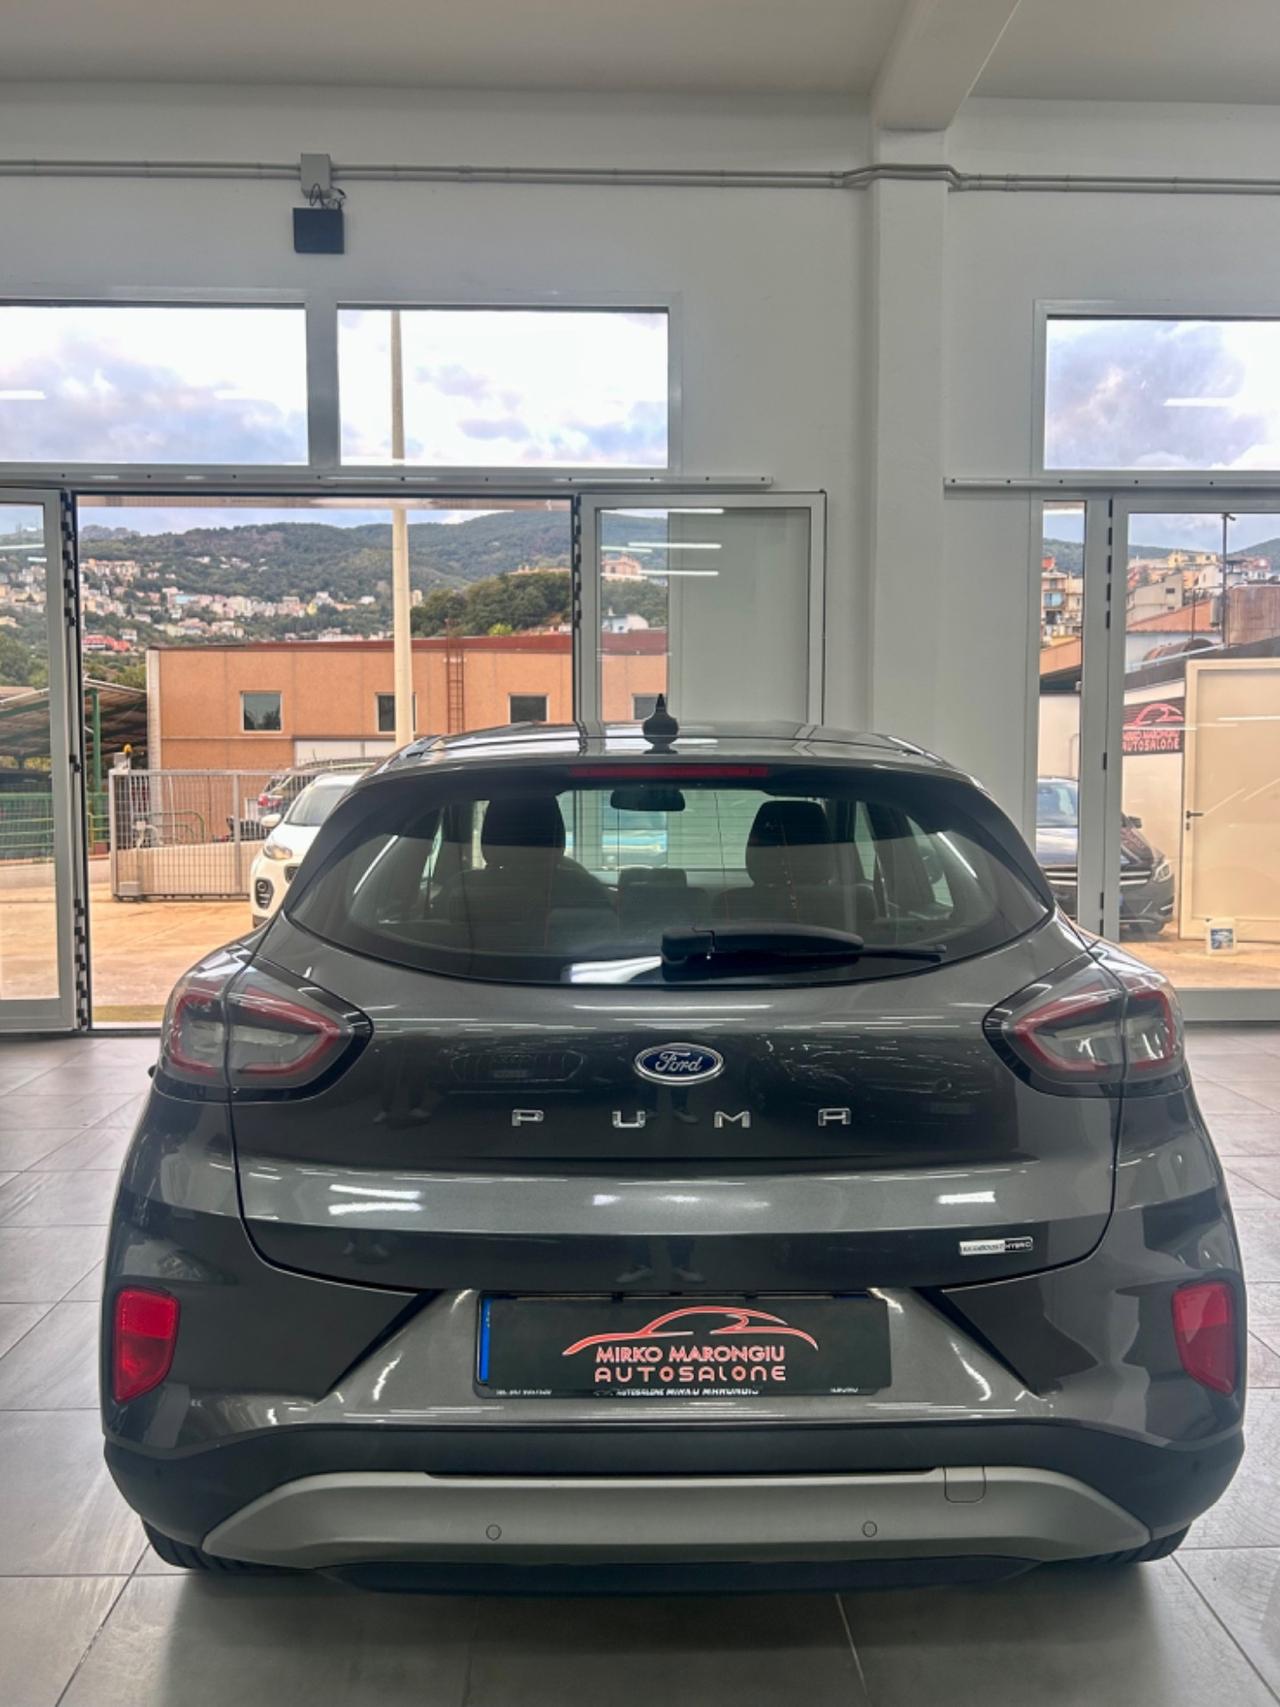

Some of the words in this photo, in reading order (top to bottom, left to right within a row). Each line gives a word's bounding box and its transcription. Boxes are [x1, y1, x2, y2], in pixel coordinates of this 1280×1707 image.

[654, 1052, 702, 1073] Ford
[511, 1107, 851, 1129] PUMA
[596, 1345, 664, 1364] MIRKO
[668, 1344, 786, 1364] MARONGIU
[594, 1365, 787, 1383] AUTOSALONE
